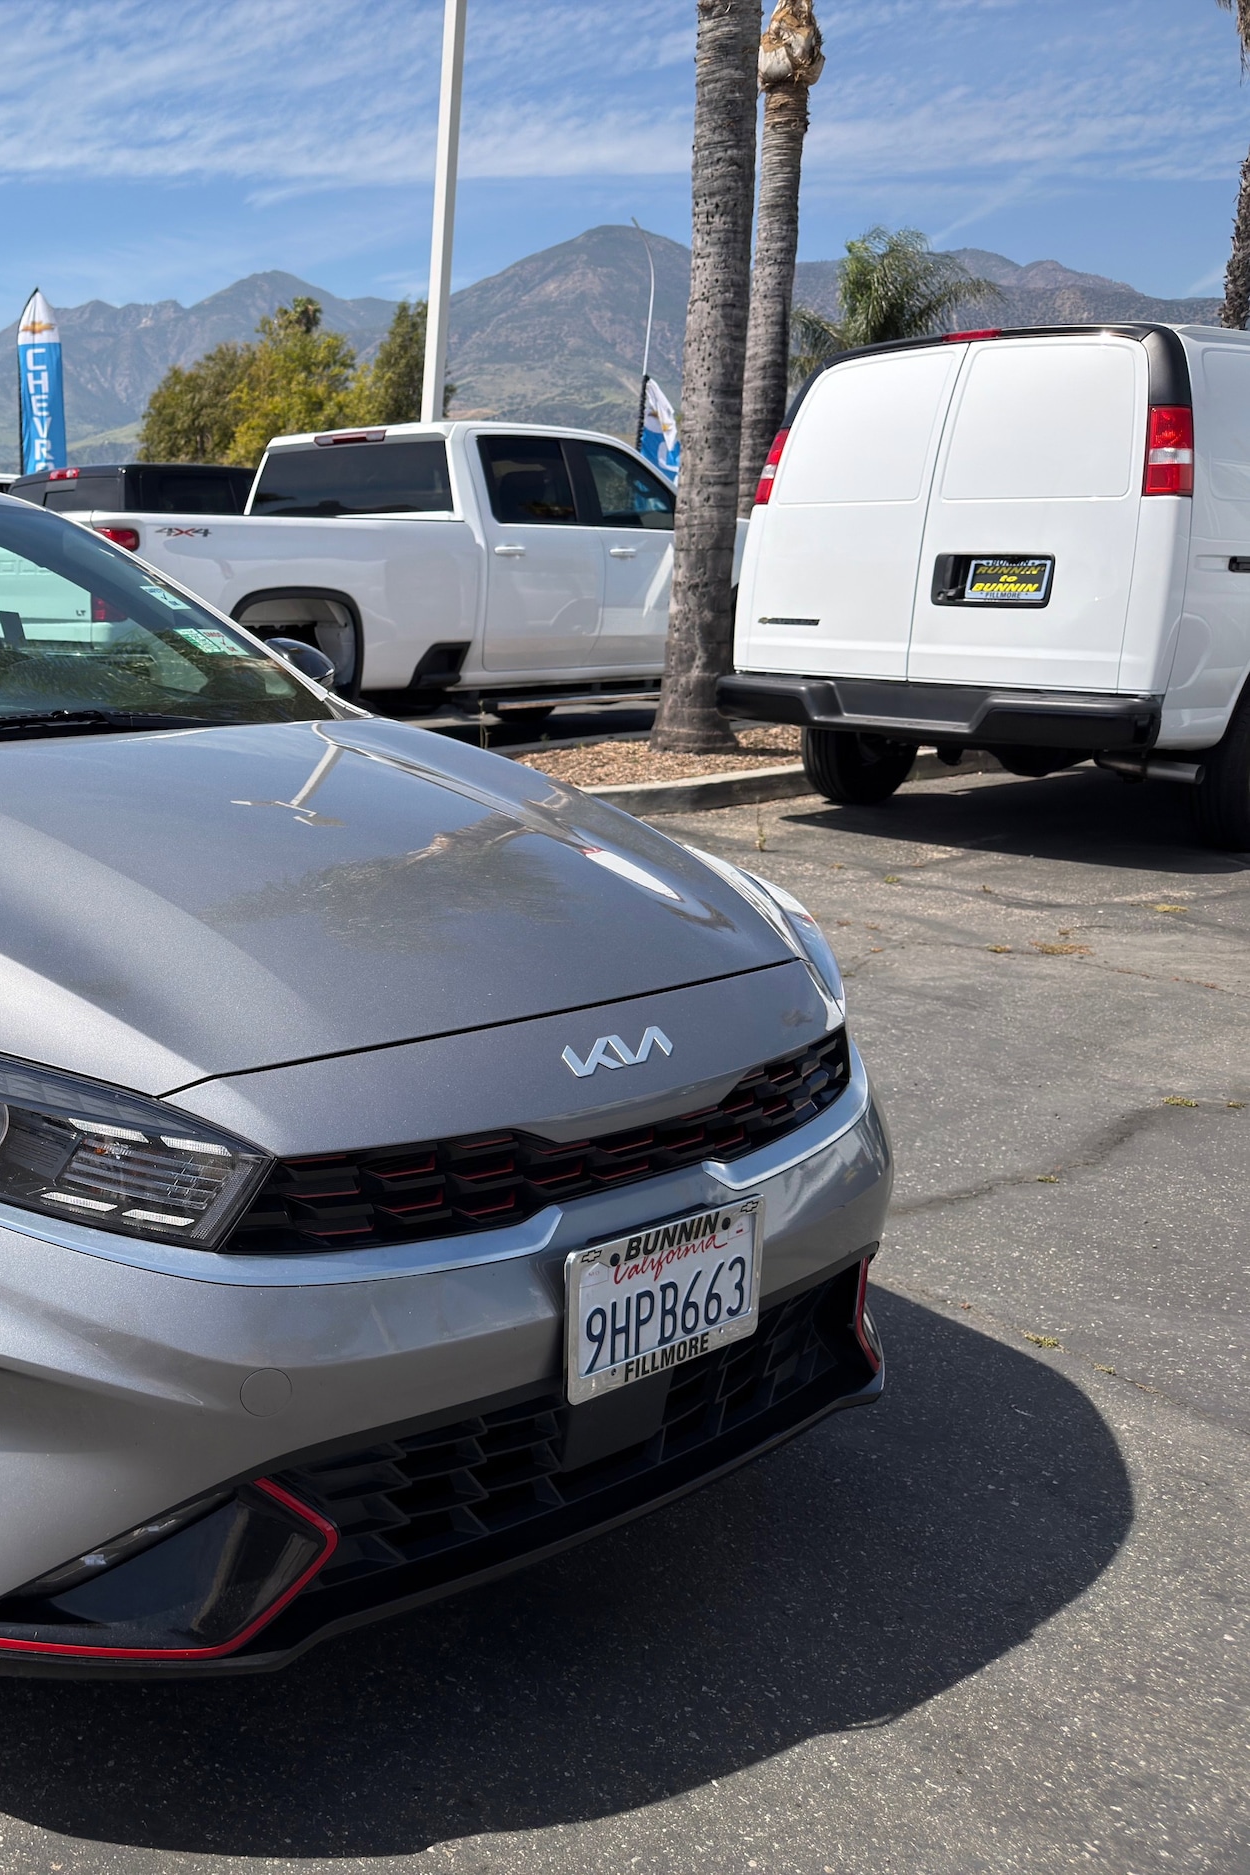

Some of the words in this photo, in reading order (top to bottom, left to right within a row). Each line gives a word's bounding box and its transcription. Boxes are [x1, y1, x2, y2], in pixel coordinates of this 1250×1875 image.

[971, 582, 1039, 593] BUNNIN
[999, 575, 1018, 583] to
[561, 1025, 673, 1078] KIA
[613, 1234, 728, 1285] California
[624, 1211, 720, 1262] BUNNIN
[585, 1256, 746, 1376] 9HPB663
[624, 1332, 710, 1383] FILLMORE
